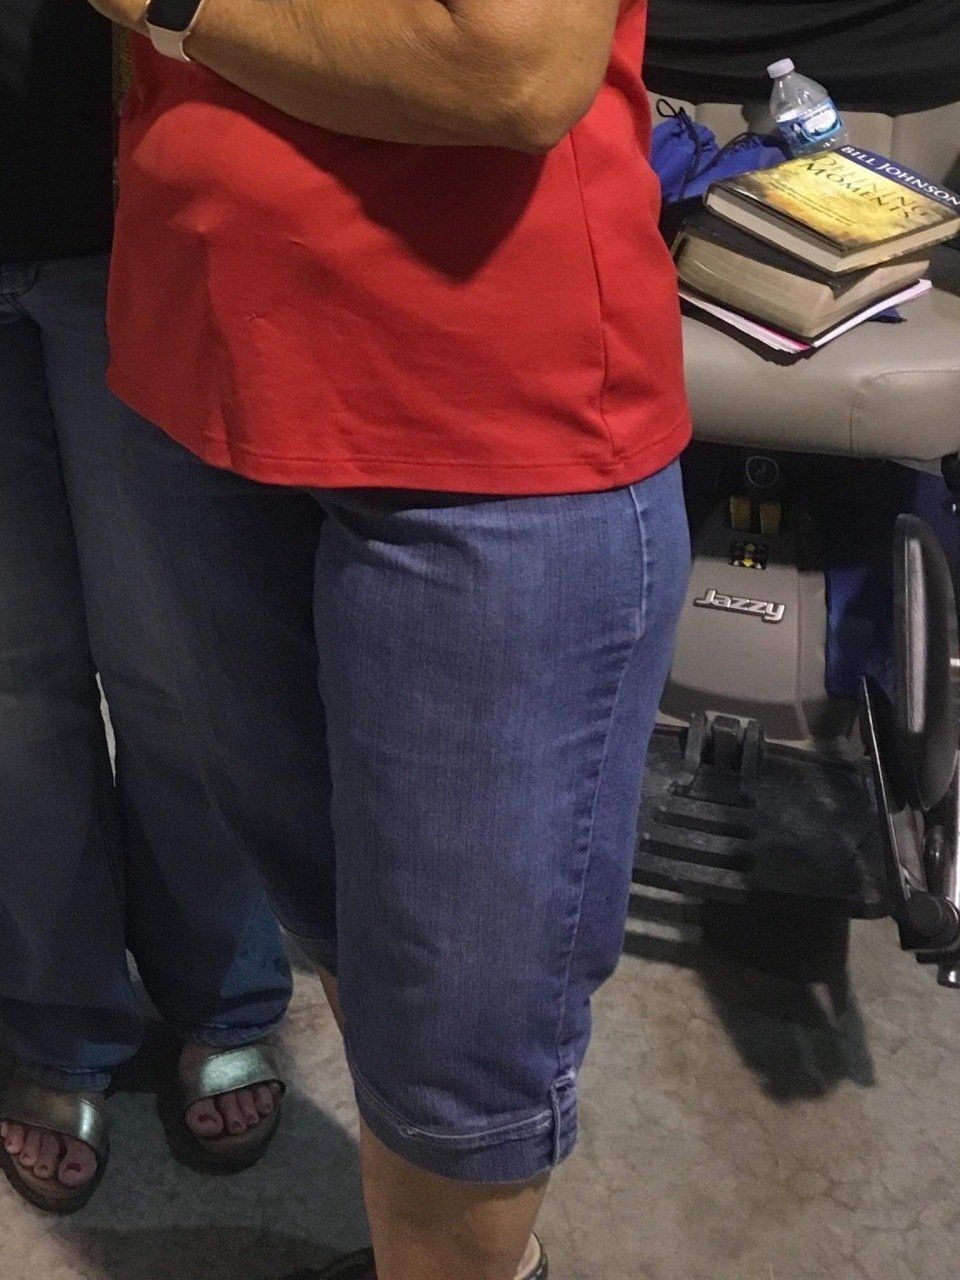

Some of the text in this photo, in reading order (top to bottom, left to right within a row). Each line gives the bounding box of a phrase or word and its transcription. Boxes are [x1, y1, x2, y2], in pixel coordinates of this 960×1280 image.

[798, 162, 912, 219] MOMENTS
[840, 146, 876, 166] BILL
[876, 163, 960, 206] JOHNSON
[695, 588, 786, 622] Jazzy
